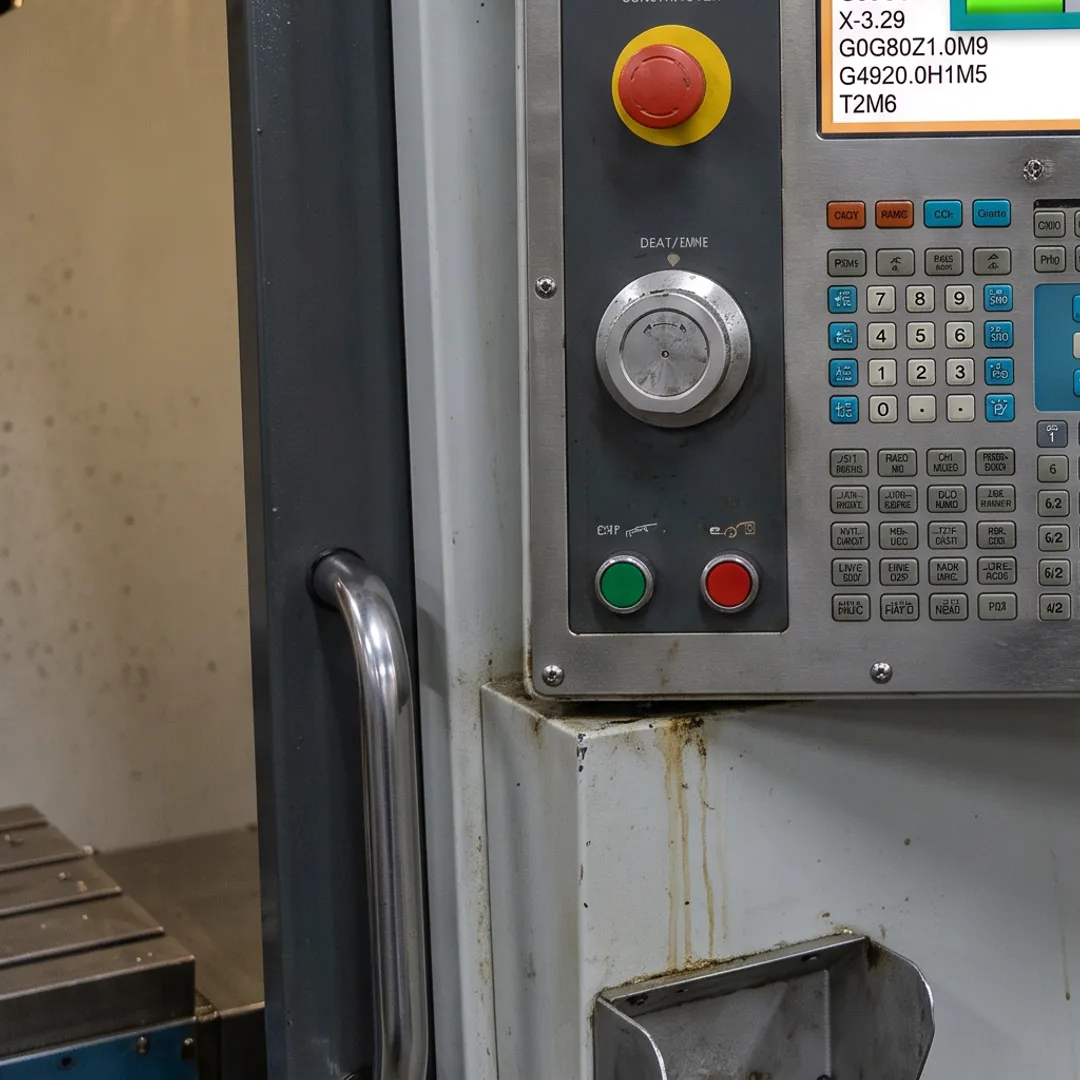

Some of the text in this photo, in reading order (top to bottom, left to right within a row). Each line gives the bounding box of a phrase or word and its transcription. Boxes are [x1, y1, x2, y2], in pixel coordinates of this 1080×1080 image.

[839, 11, 904, 29] X-3.29
[839, 37, 988, 57] G0G80Z1.0M9
[839, 65, 987, 85] G4920.0H1M5
[839, 94, 896, 113] T2M6
[876, 292, 886, 306] 7
[915, 292, 925, 305] 8
[954, 291, 965, 305] 9
[876, 329, 886, 343] 4
[915, 328, 926, 342] 5
[955, 328, 965, 342] 6
[878, 366, 884, 380] 1
[916, 366, 927, 380] 2
[955, 365, 965, 379] 3
[877, 402, 889, 417] 0
